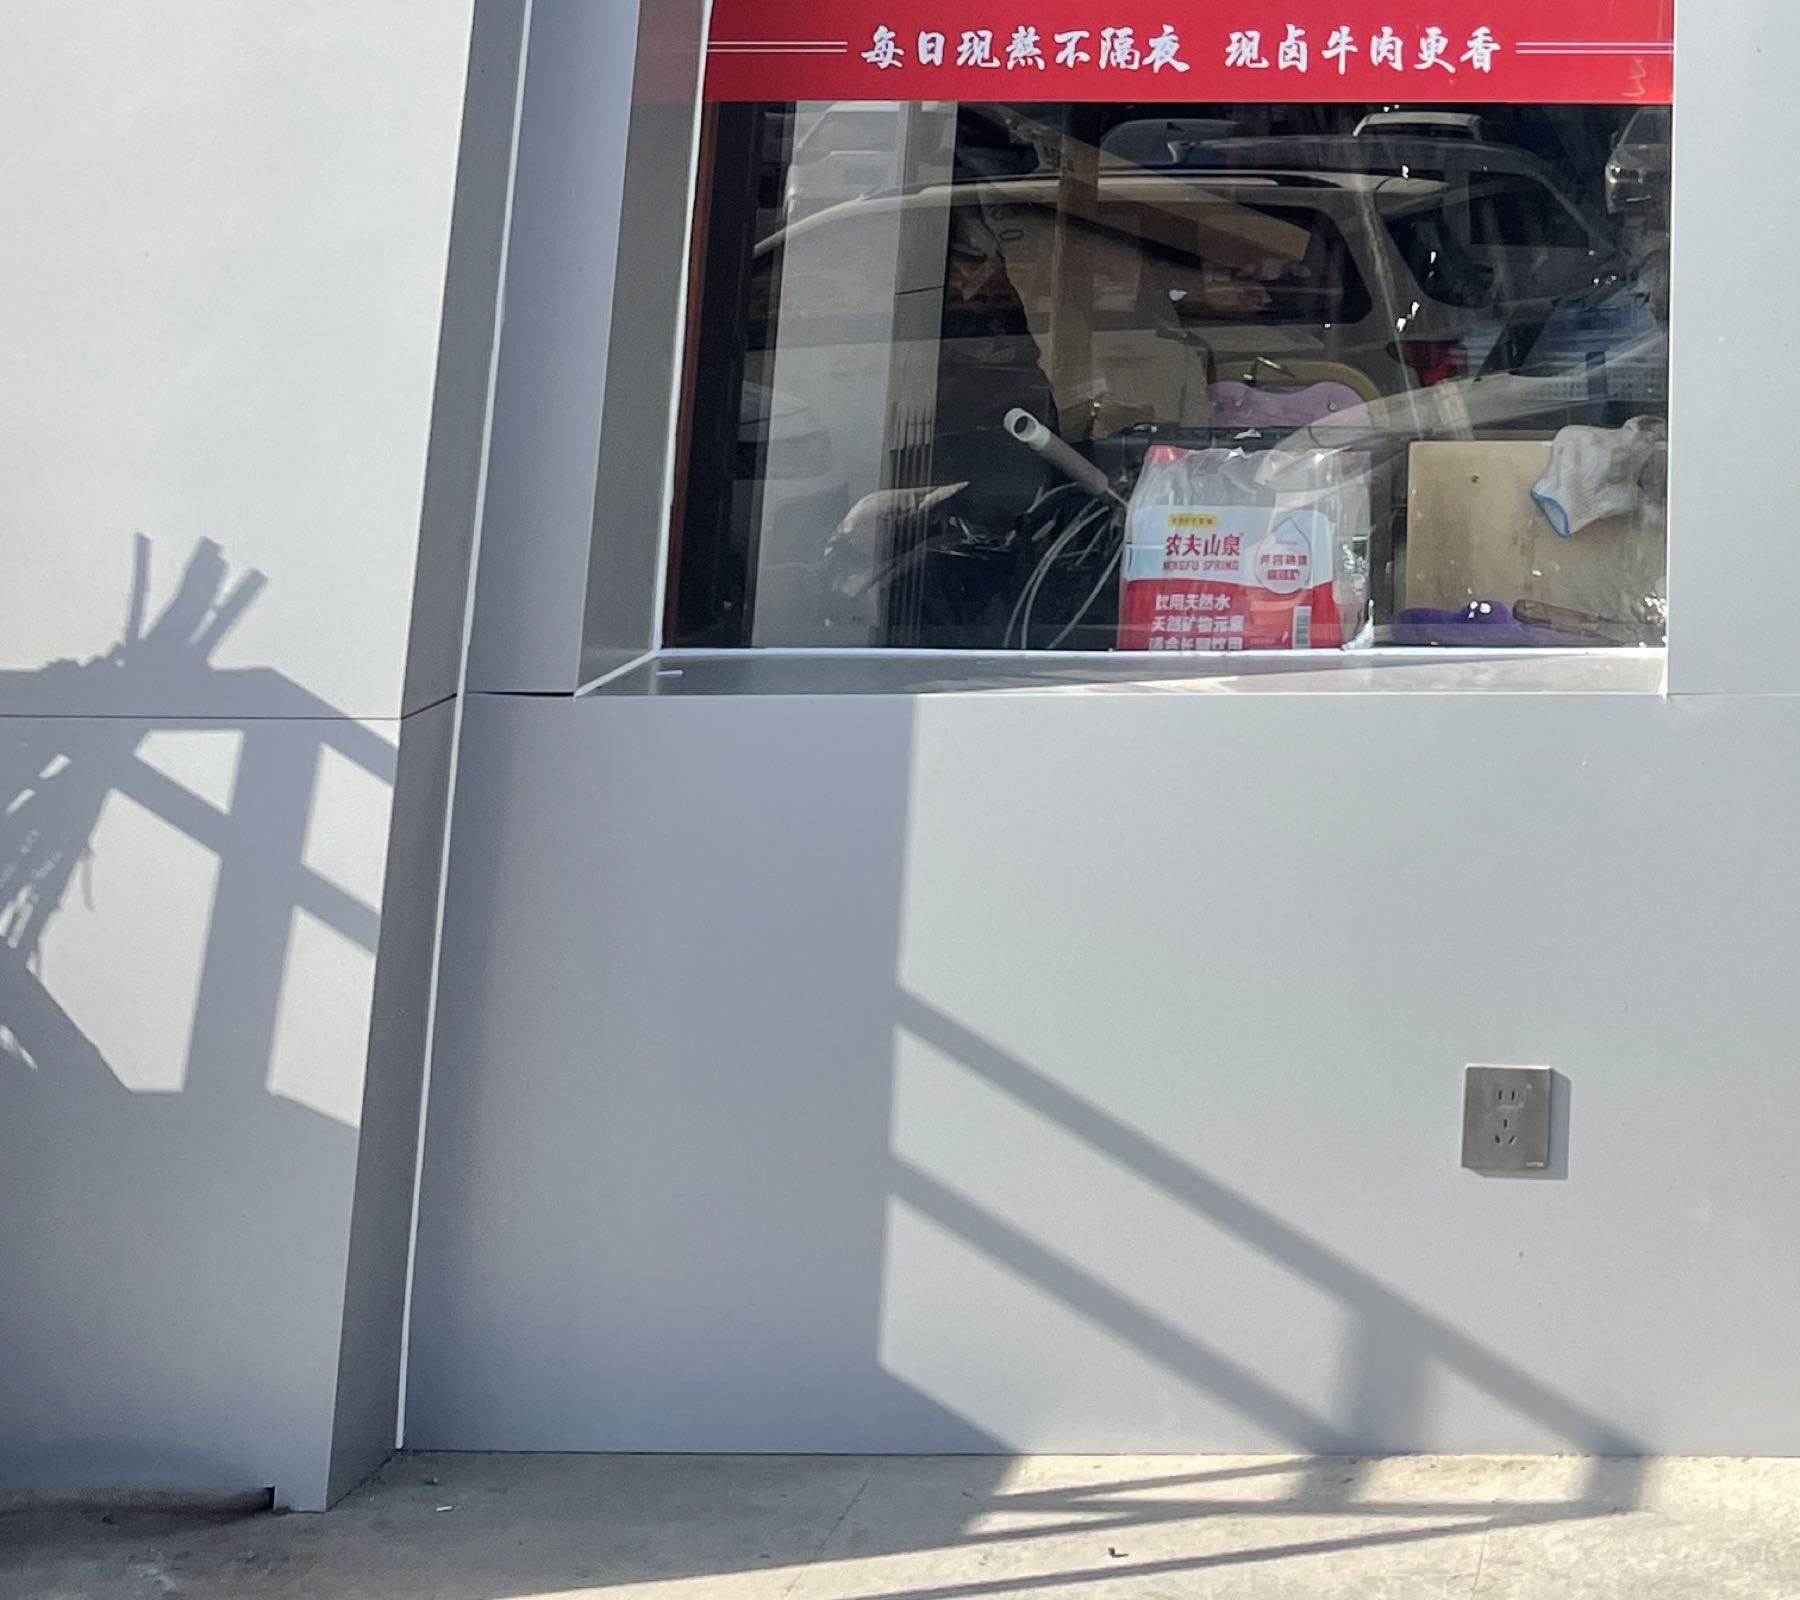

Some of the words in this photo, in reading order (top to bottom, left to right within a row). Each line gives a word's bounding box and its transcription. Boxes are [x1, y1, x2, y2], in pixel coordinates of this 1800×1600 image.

[860, 24, 1190, 75] 每日现熬不隔夜
[1223, 25, 1503, 76] 现卤牛肉更香
[1166, 533, 1242, 557] 农夫山泉
[1155, 593, 1231, 611] 饮用天然水
